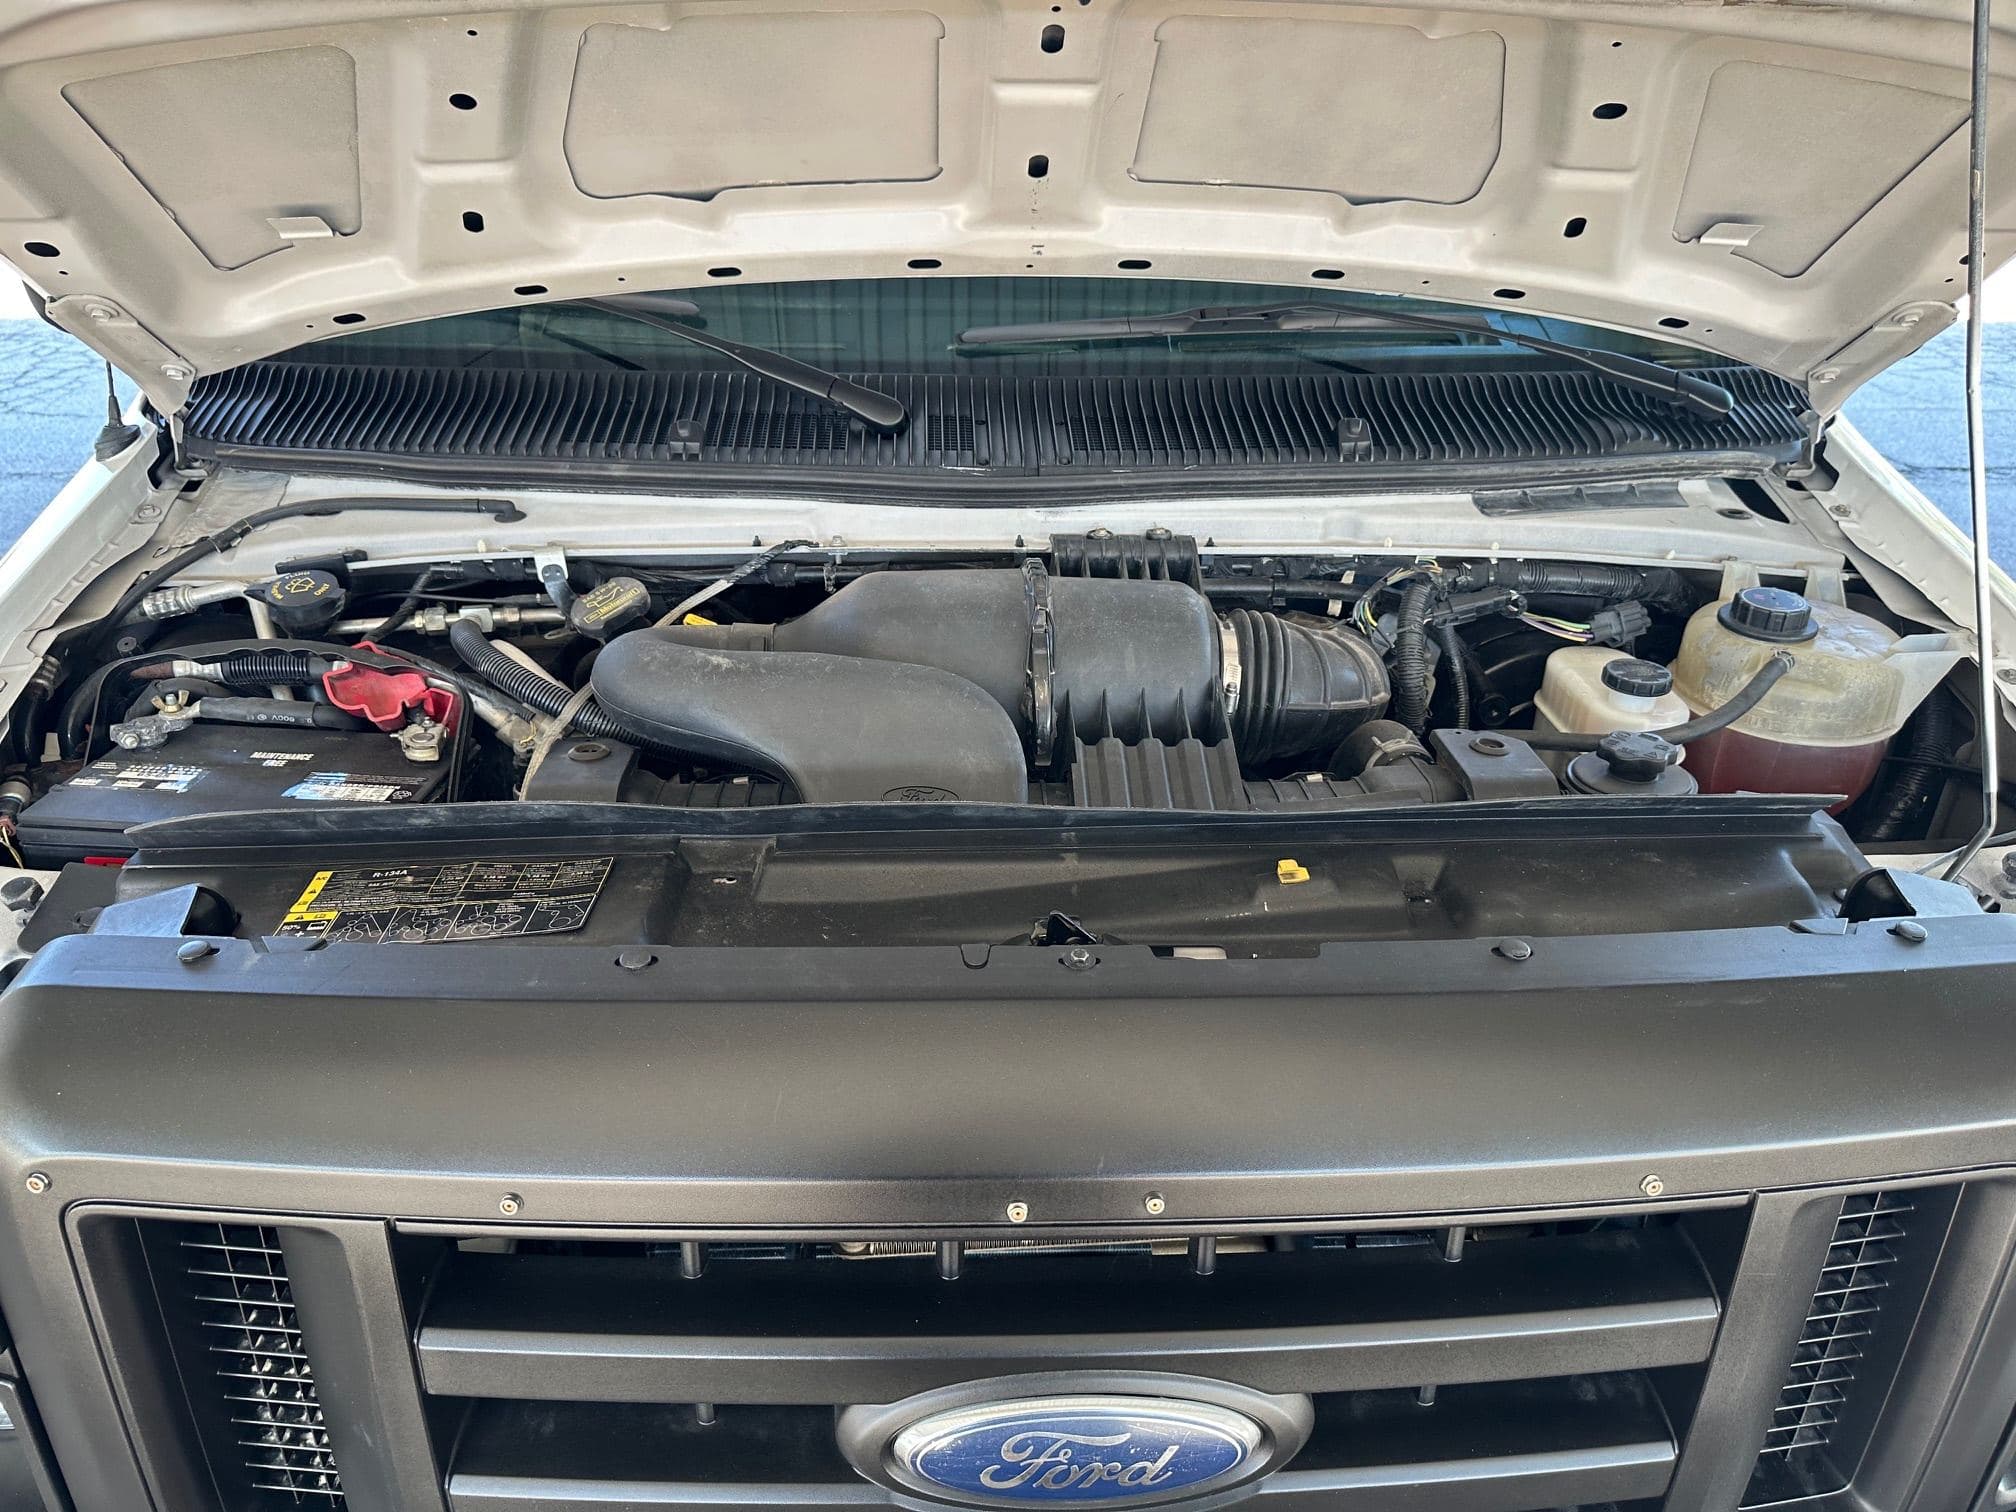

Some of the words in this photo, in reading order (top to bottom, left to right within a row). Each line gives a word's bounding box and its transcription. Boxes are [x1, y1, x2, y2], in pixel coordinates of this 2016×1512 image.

[250, 751, 314, 761] MAINTENANCE
[262, 759, 289, 767] FREE
[372, 869, 408, 878] R-134A
[980, 1431, 1180, 1490] Ford
